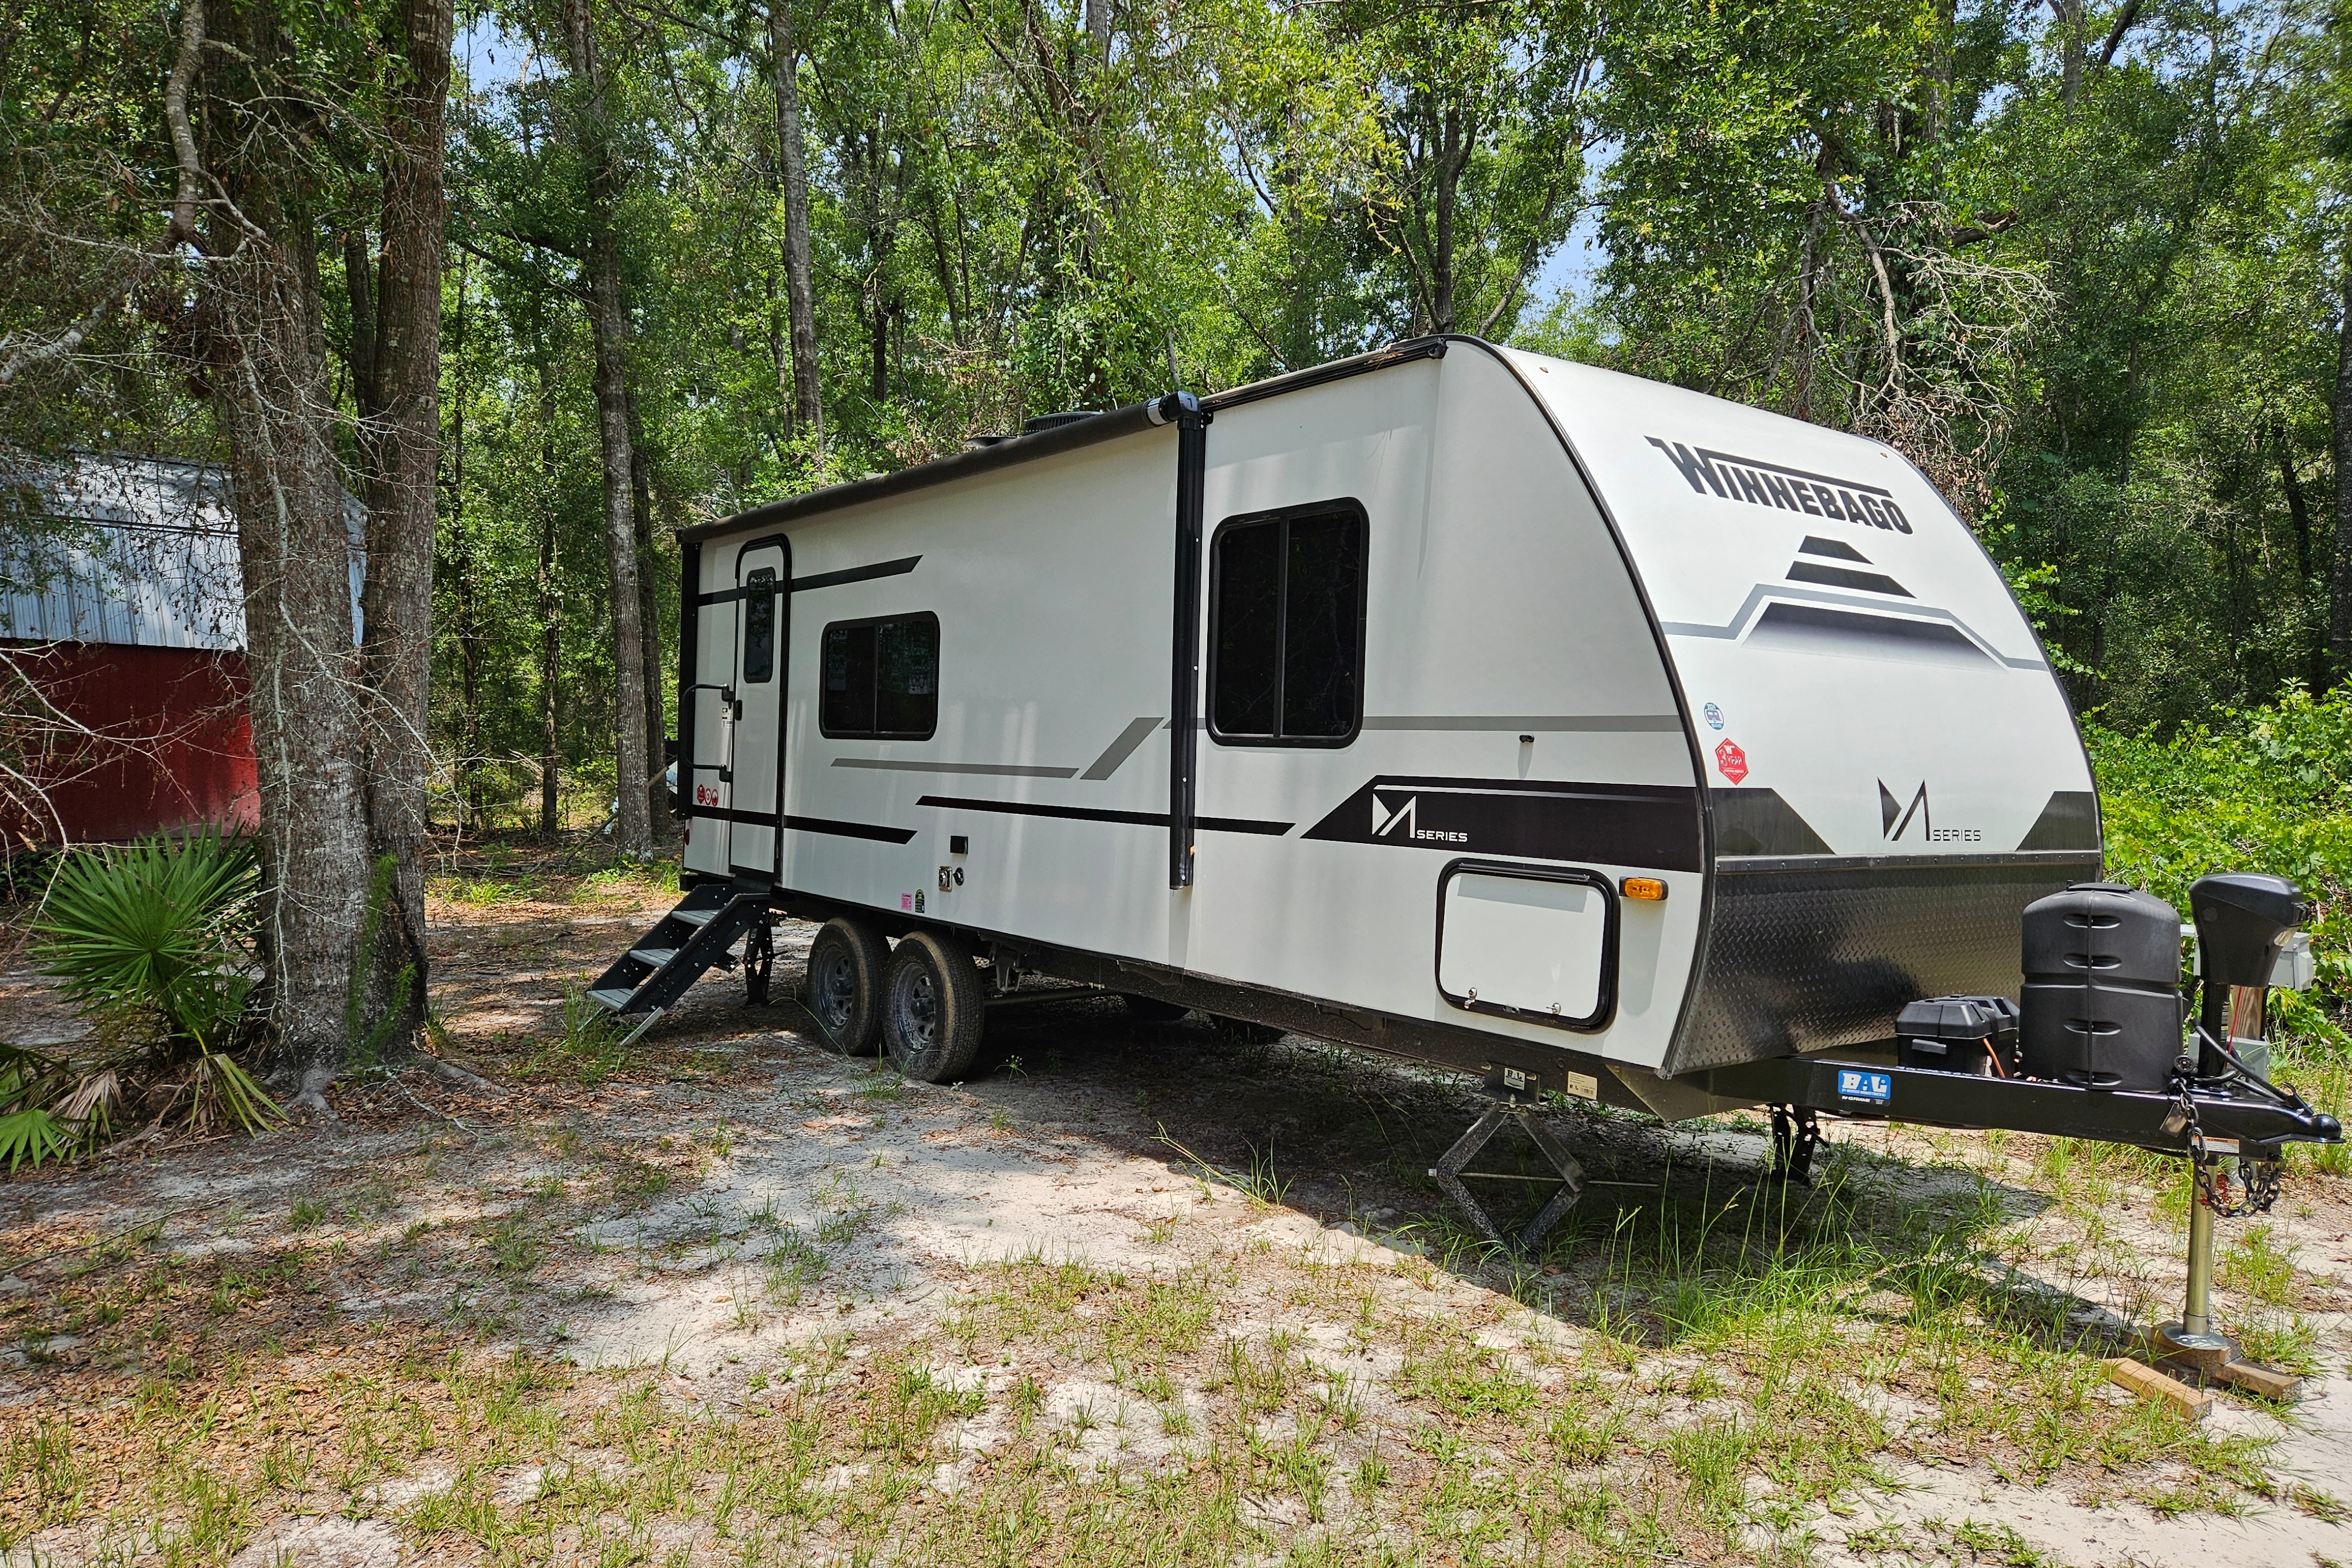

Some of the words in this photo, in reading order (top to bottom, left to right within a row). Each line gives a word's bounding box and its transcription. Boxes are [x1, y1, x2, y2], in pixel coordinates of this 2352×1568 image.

[1643, 436, 1913, 534] WINNEBAGO
[1416, 830, 1468, 842] SERIES
[1933, 830, 1981, 841] SERIES
